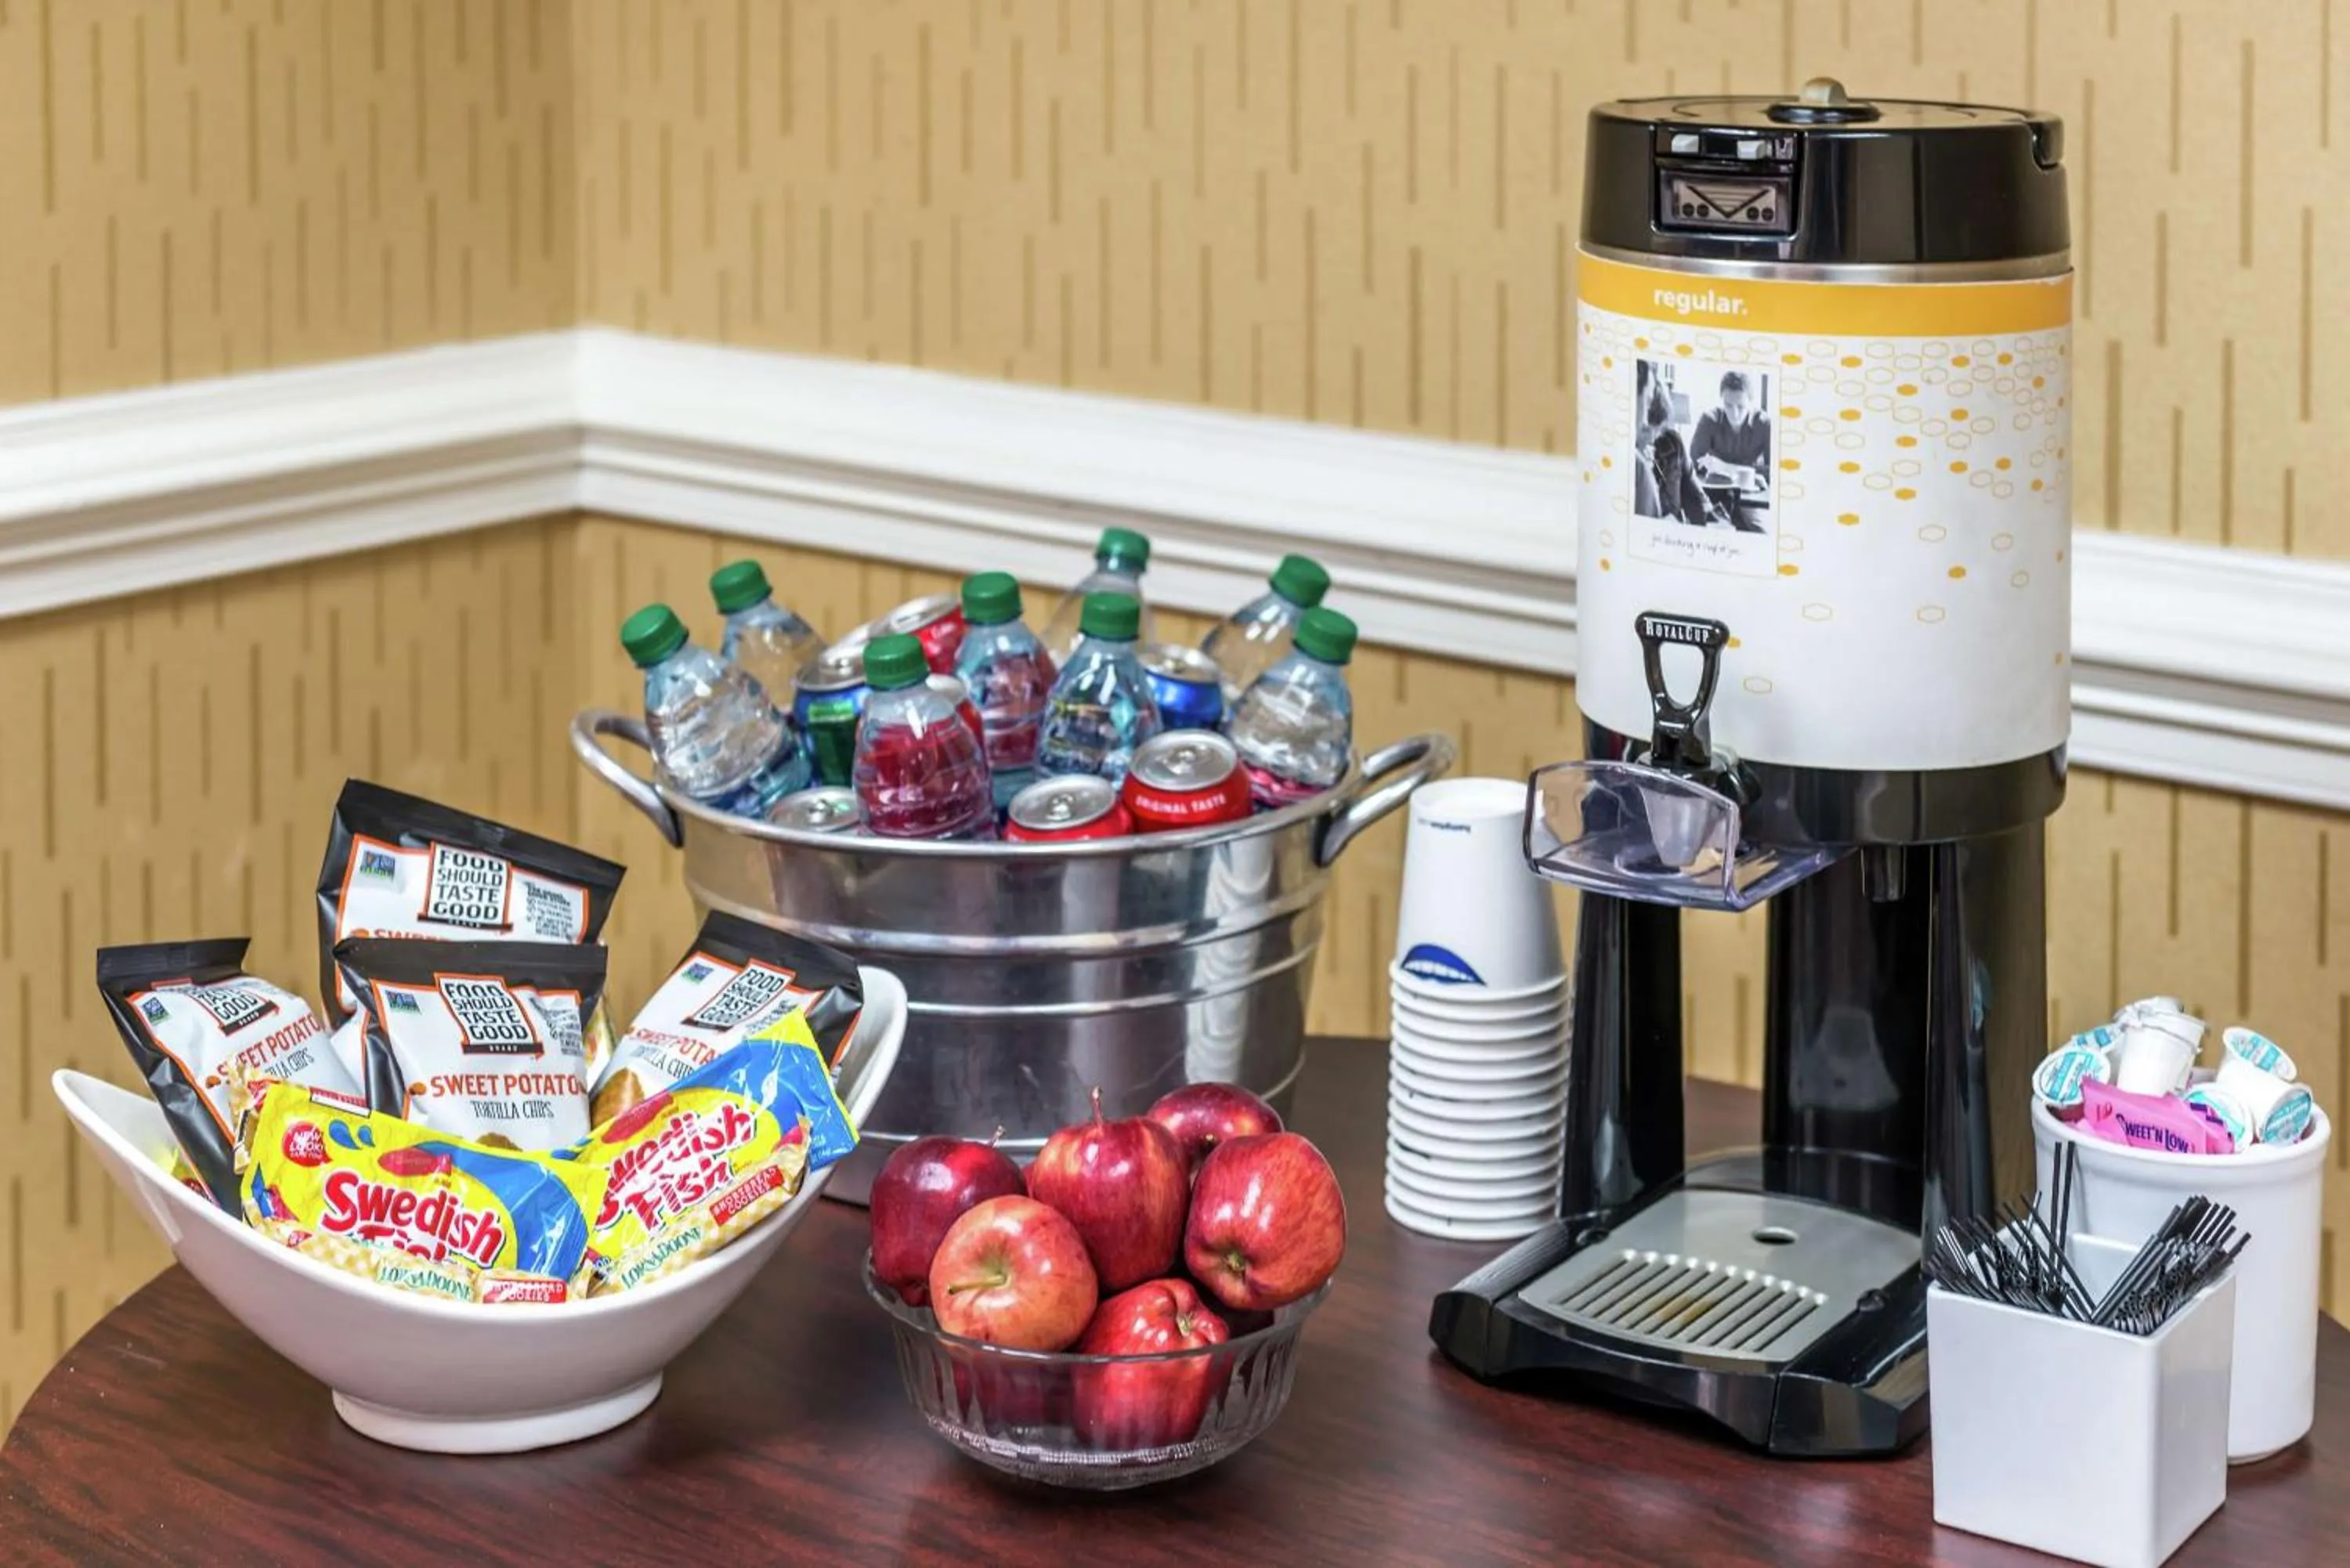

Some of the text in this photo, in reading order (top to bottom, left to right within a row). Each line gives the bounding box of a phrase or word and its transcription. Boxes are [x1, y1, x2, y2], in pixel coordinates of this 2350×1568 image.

[1654, 289, 1748, 316] regular.
[439, 849, 504, 873] FOOD
[437, 867, 503, 887] SHOULD
[436, 883, 501, 903] TASTE
[433, 901, 499, 920] GOOD
[444, 983, 504, 999] FOOD
[738, 969, 784, 993] FOOD
[214, 993, 258, 1019] GOOD
[452, 997, 513, 1010] SHOULD
[715, 993, 759, 1016] TASTE
[458, 1010, 521, 1024] TASTE
[469, 1024, 529, 1040] GOOD
[217, 1042, 267, 1076] SEET
[668, 1035, 718, 1065] POTA
[432, 1073, 581, 1097] SWEET POTATO
[472, 1100, 555, 1119] TORTILLA CHIPS
[2164, 1126, 2189, 1154] LOW
[625, 1157, 732, 1232] Fish
[321, 1171, 504, 1265] Swedish
